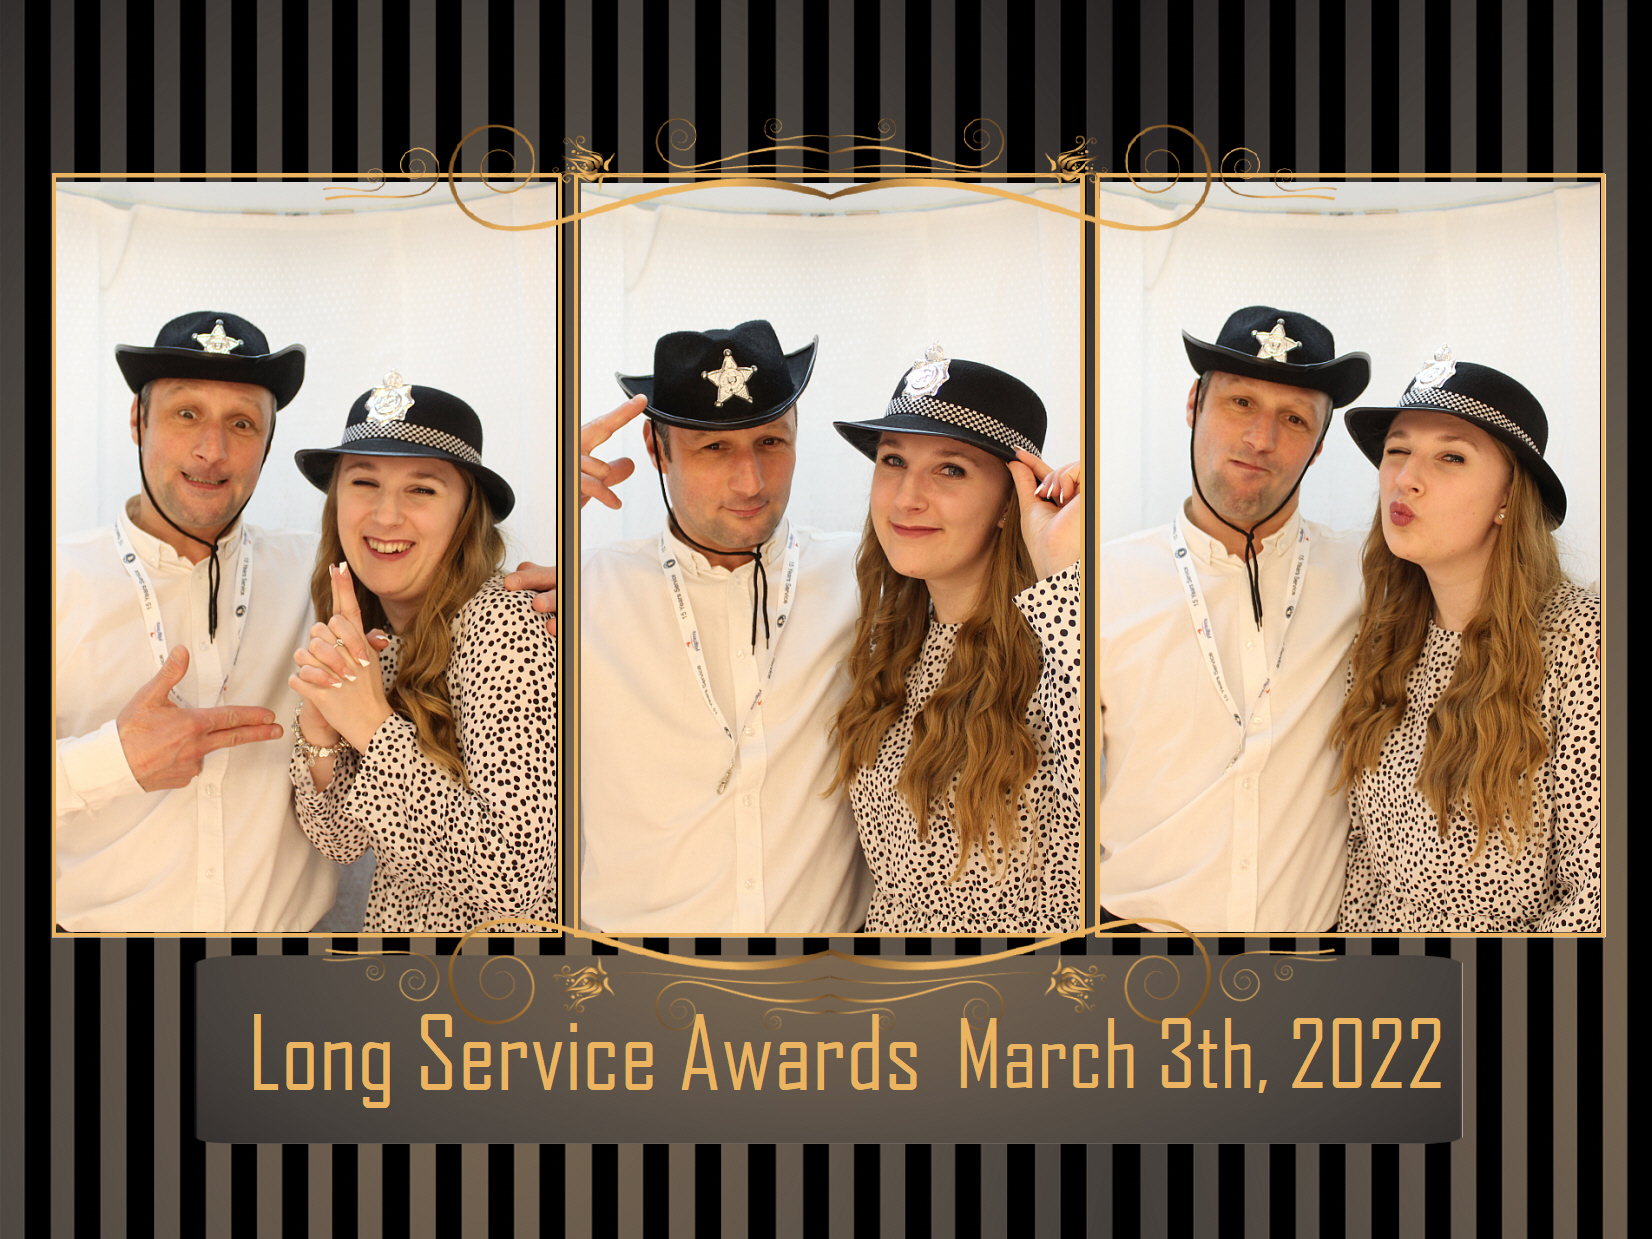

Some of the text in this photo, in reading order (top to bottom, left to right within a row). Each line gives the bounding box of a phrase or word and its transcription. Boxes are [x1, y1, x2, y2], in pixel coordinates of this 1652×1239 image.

[677, 593, 685, 611] Years
[783, 583, 791, 604] Service
[145, 602, 152, 610] 15
[1192, 599, 1199, 607] 15
[681, 611, 687, 620] 15
[1208, 651, 1219, 676] Service
[697, 664, 707, 689] Service
